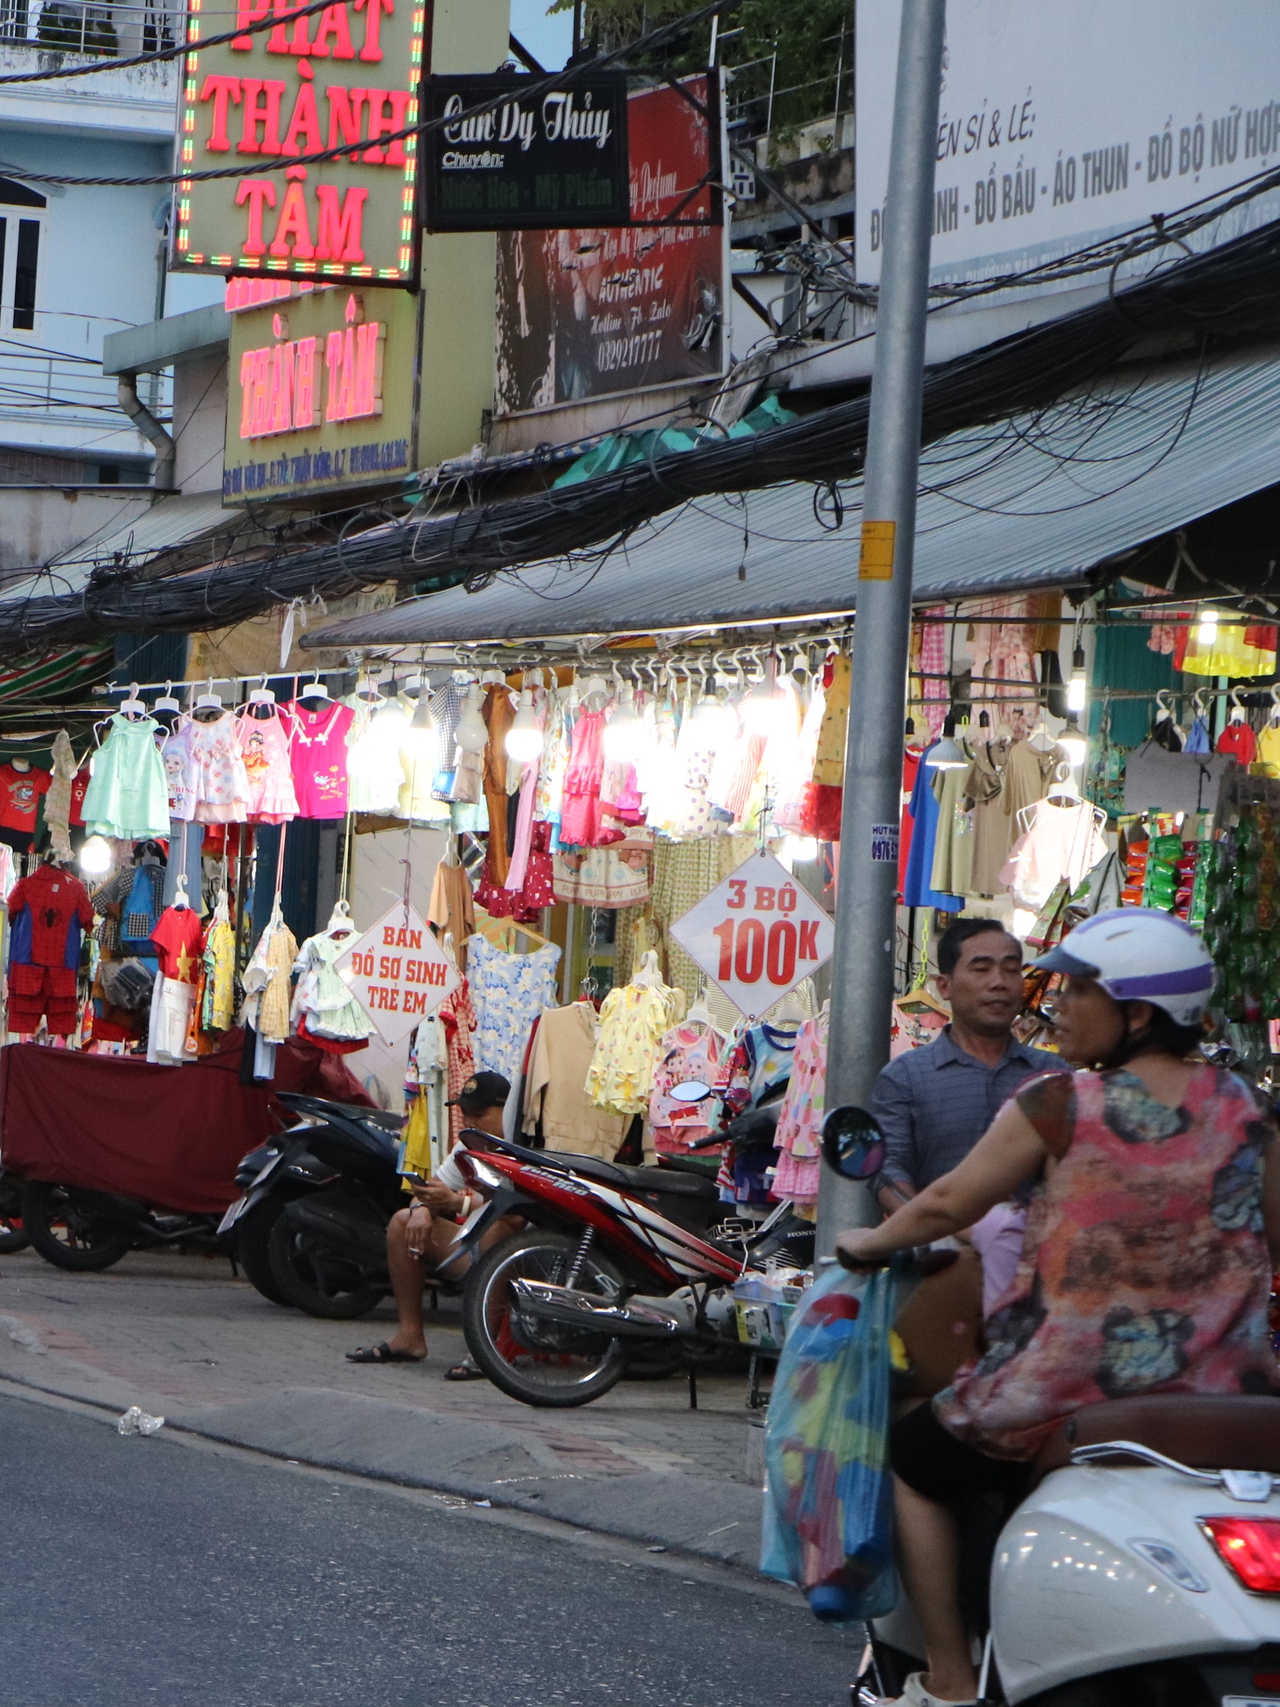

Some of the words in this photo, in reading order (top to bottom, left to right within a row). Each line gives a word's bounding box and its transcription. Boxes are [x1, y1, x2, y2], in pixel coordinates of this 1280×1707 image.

[200, 58, 411, 168] THÀNH
[542, 91, 613, 149] Thủy
[988, 109, 1002, 147] &
[441, 151, 504, 169] Chuyên:
[1052, 149, 1076, 207] ÁO
[1082, 142, 1130, 199] THUN
[1178, 113, 1205, 184] BỘ
[1210, 105, 1242, 168] NỮ
[487, 175, 520, 208] Hoa
[234, 164, 369, 263] TÂM
[240, 313, 317, 439] THÀNH
[326, 293, 380, 423] TÂM
[727, 879, 747, 910] 3
[754, 881, 797, 918] BỘ
[382, 922, 423, 950] BÁN
[713, 918, 820, 985] 100K
[351, 945, 375, 978] ĐỒ
[379, 956, 403, 980] SƠ
[405, 959, 448, 987] SINH
[368, 982, 400, 1011] TRẺ
[402, 990, 428, 1015] EM
[787, 1230, 816, 1238] HOND
